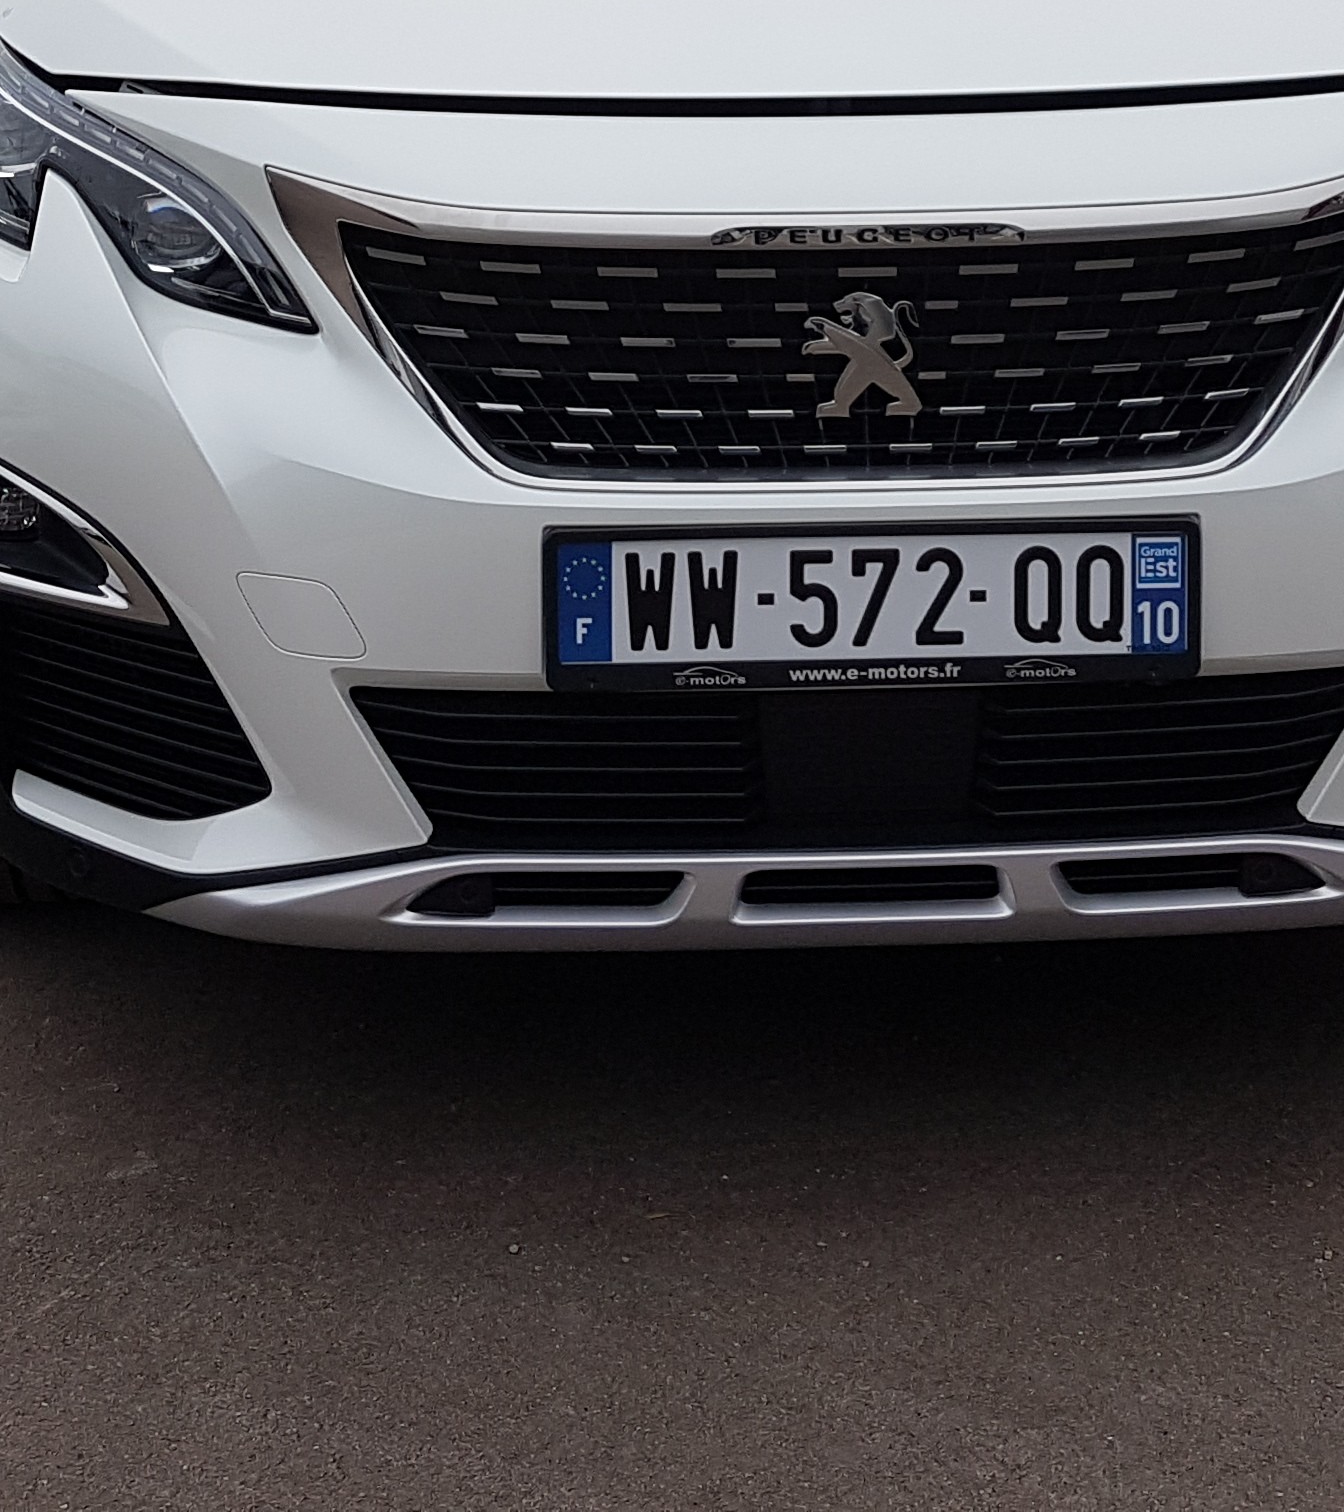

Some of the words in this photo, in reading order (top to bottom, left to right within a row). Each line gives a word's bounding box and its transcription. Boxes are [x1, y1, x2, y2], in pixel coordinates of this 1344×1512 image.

[753, 227, 978, 244] PEUGEOT
[1140, 546, 1178, 557] Grand
[1140, 558, 1177, 577] Est
[575, 617, 593, 645] F
[1137, 600, 1179, 644] 10
[789, 663, 961, 681] www.e-motors.fr
